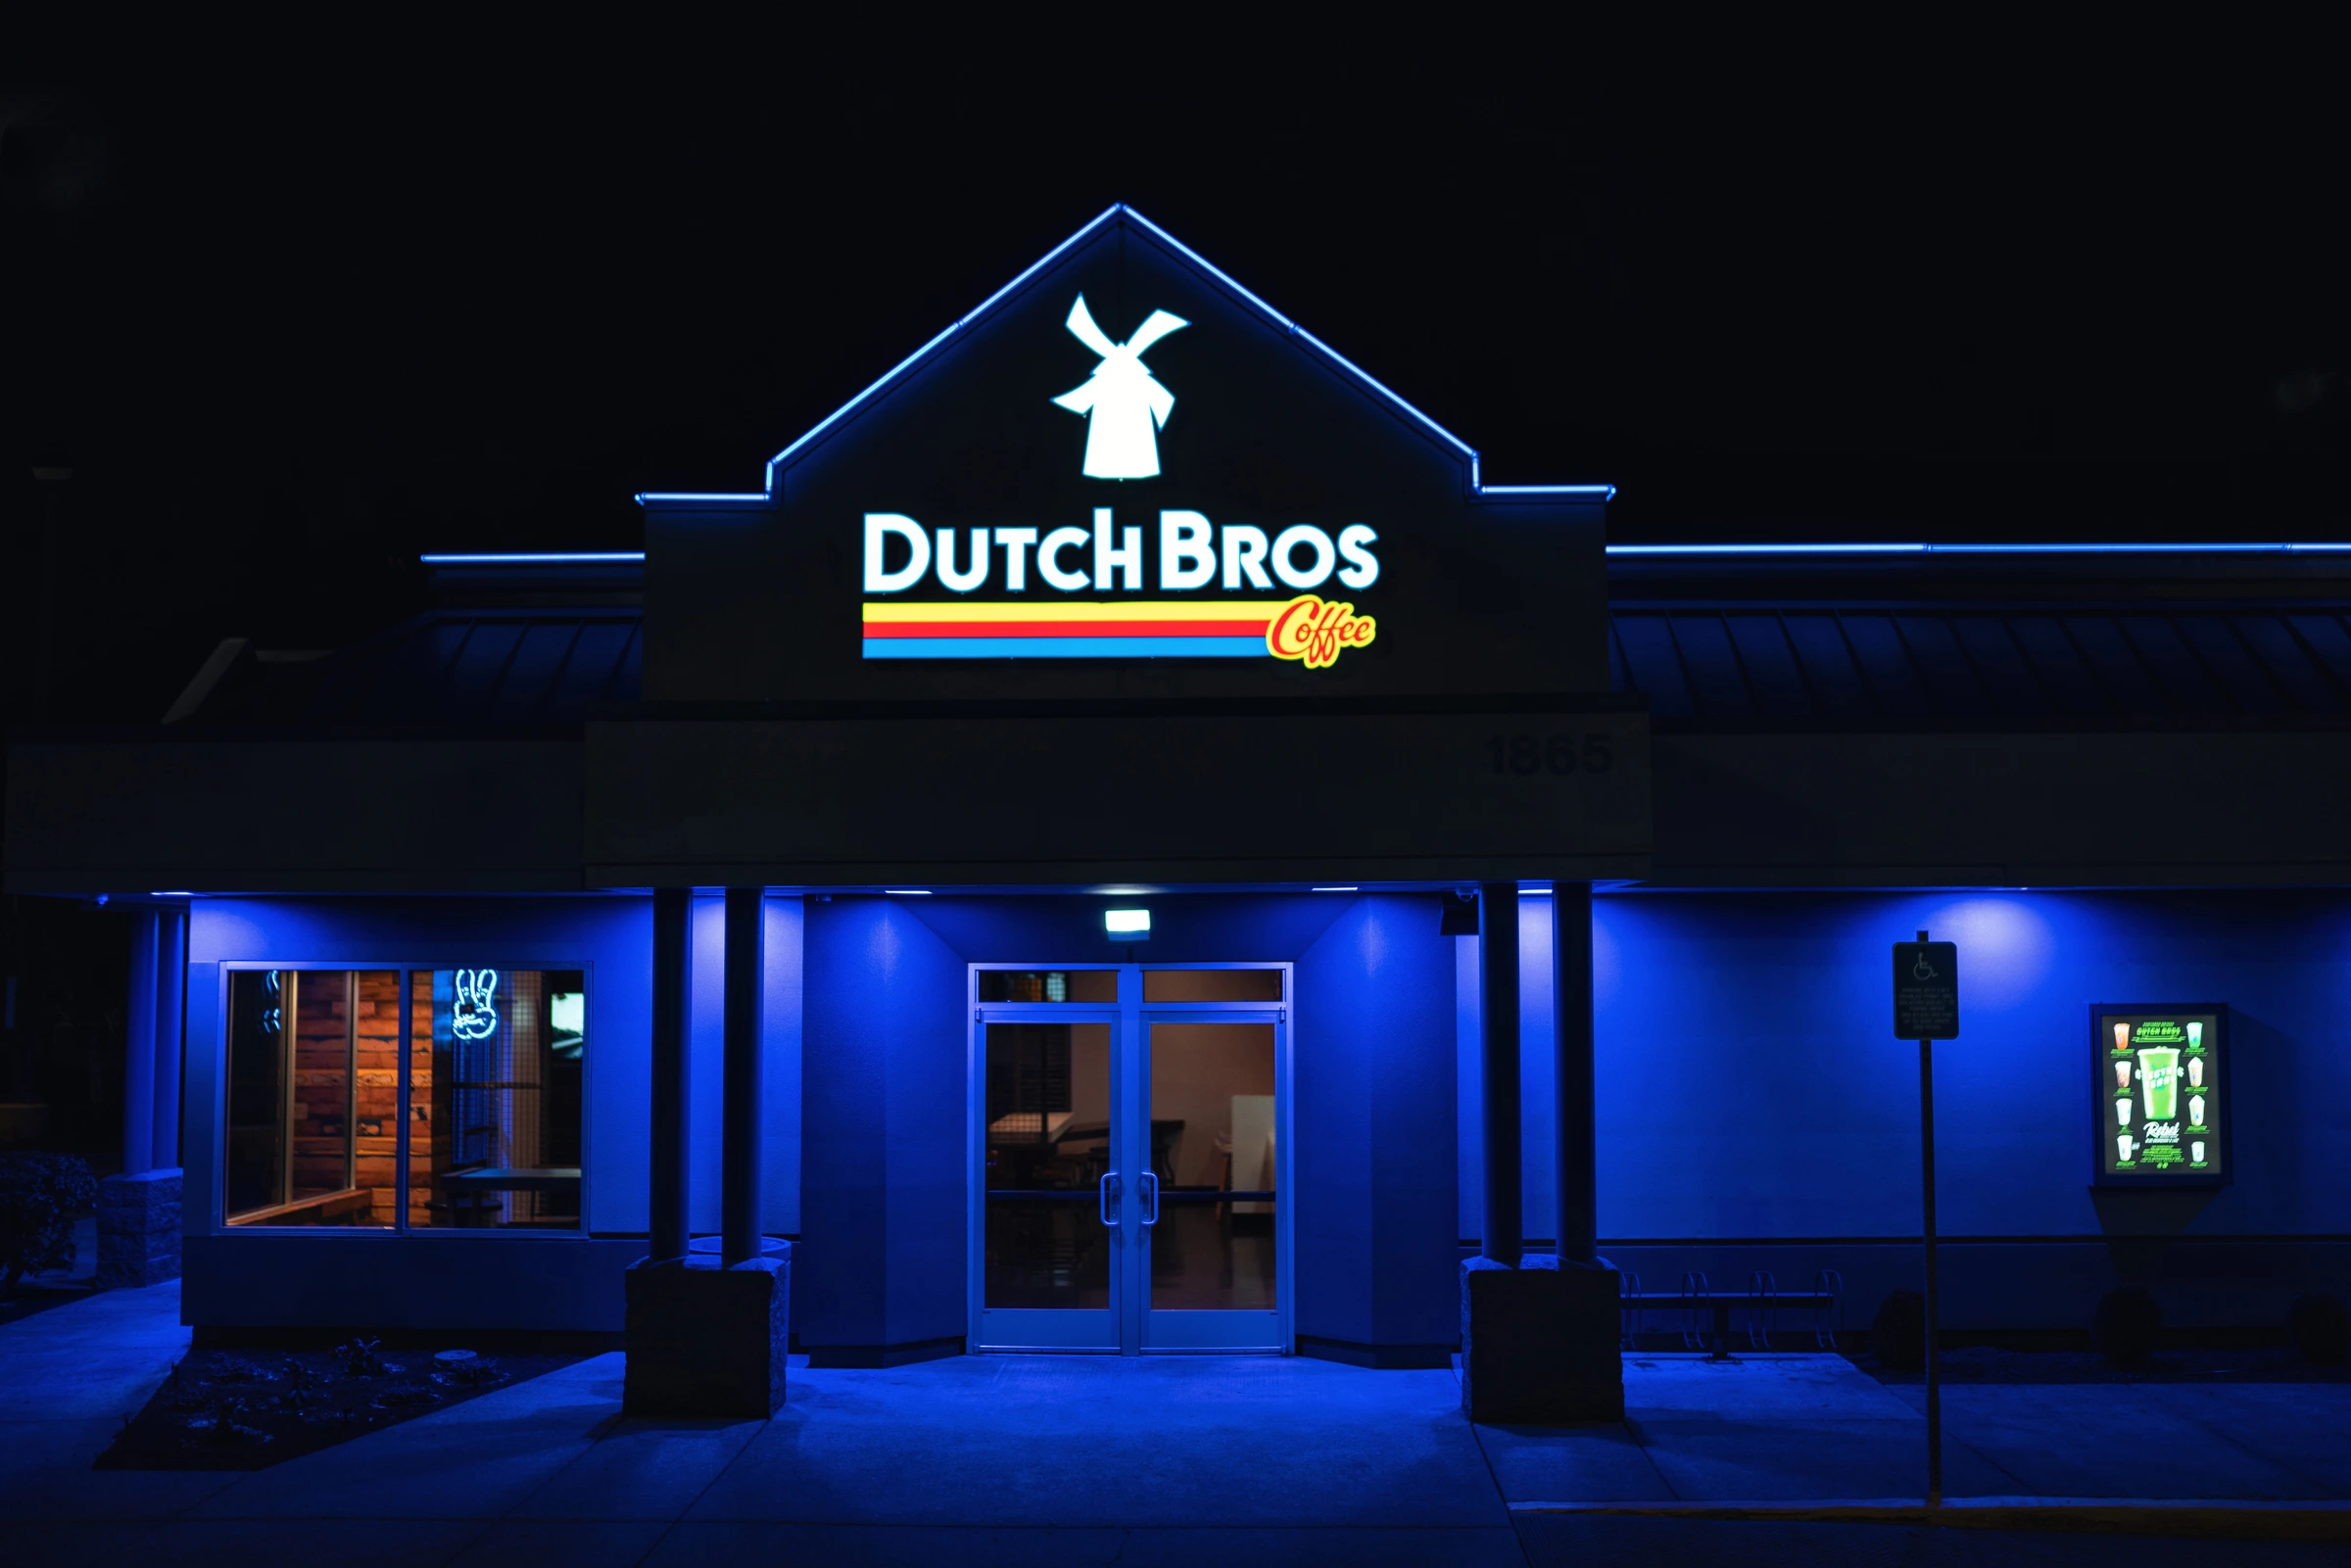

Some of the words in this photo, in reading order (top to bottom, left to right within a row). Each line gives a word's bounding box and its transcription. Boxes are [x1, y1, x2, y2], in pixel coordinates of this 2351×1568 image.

[863, 507, 1142, 593] DUTCH
[1159, 509, 1380, 590] BROS
[1271, 597, 1373, 665] Coffee
[1484, 733, 1613, 776] 1865
